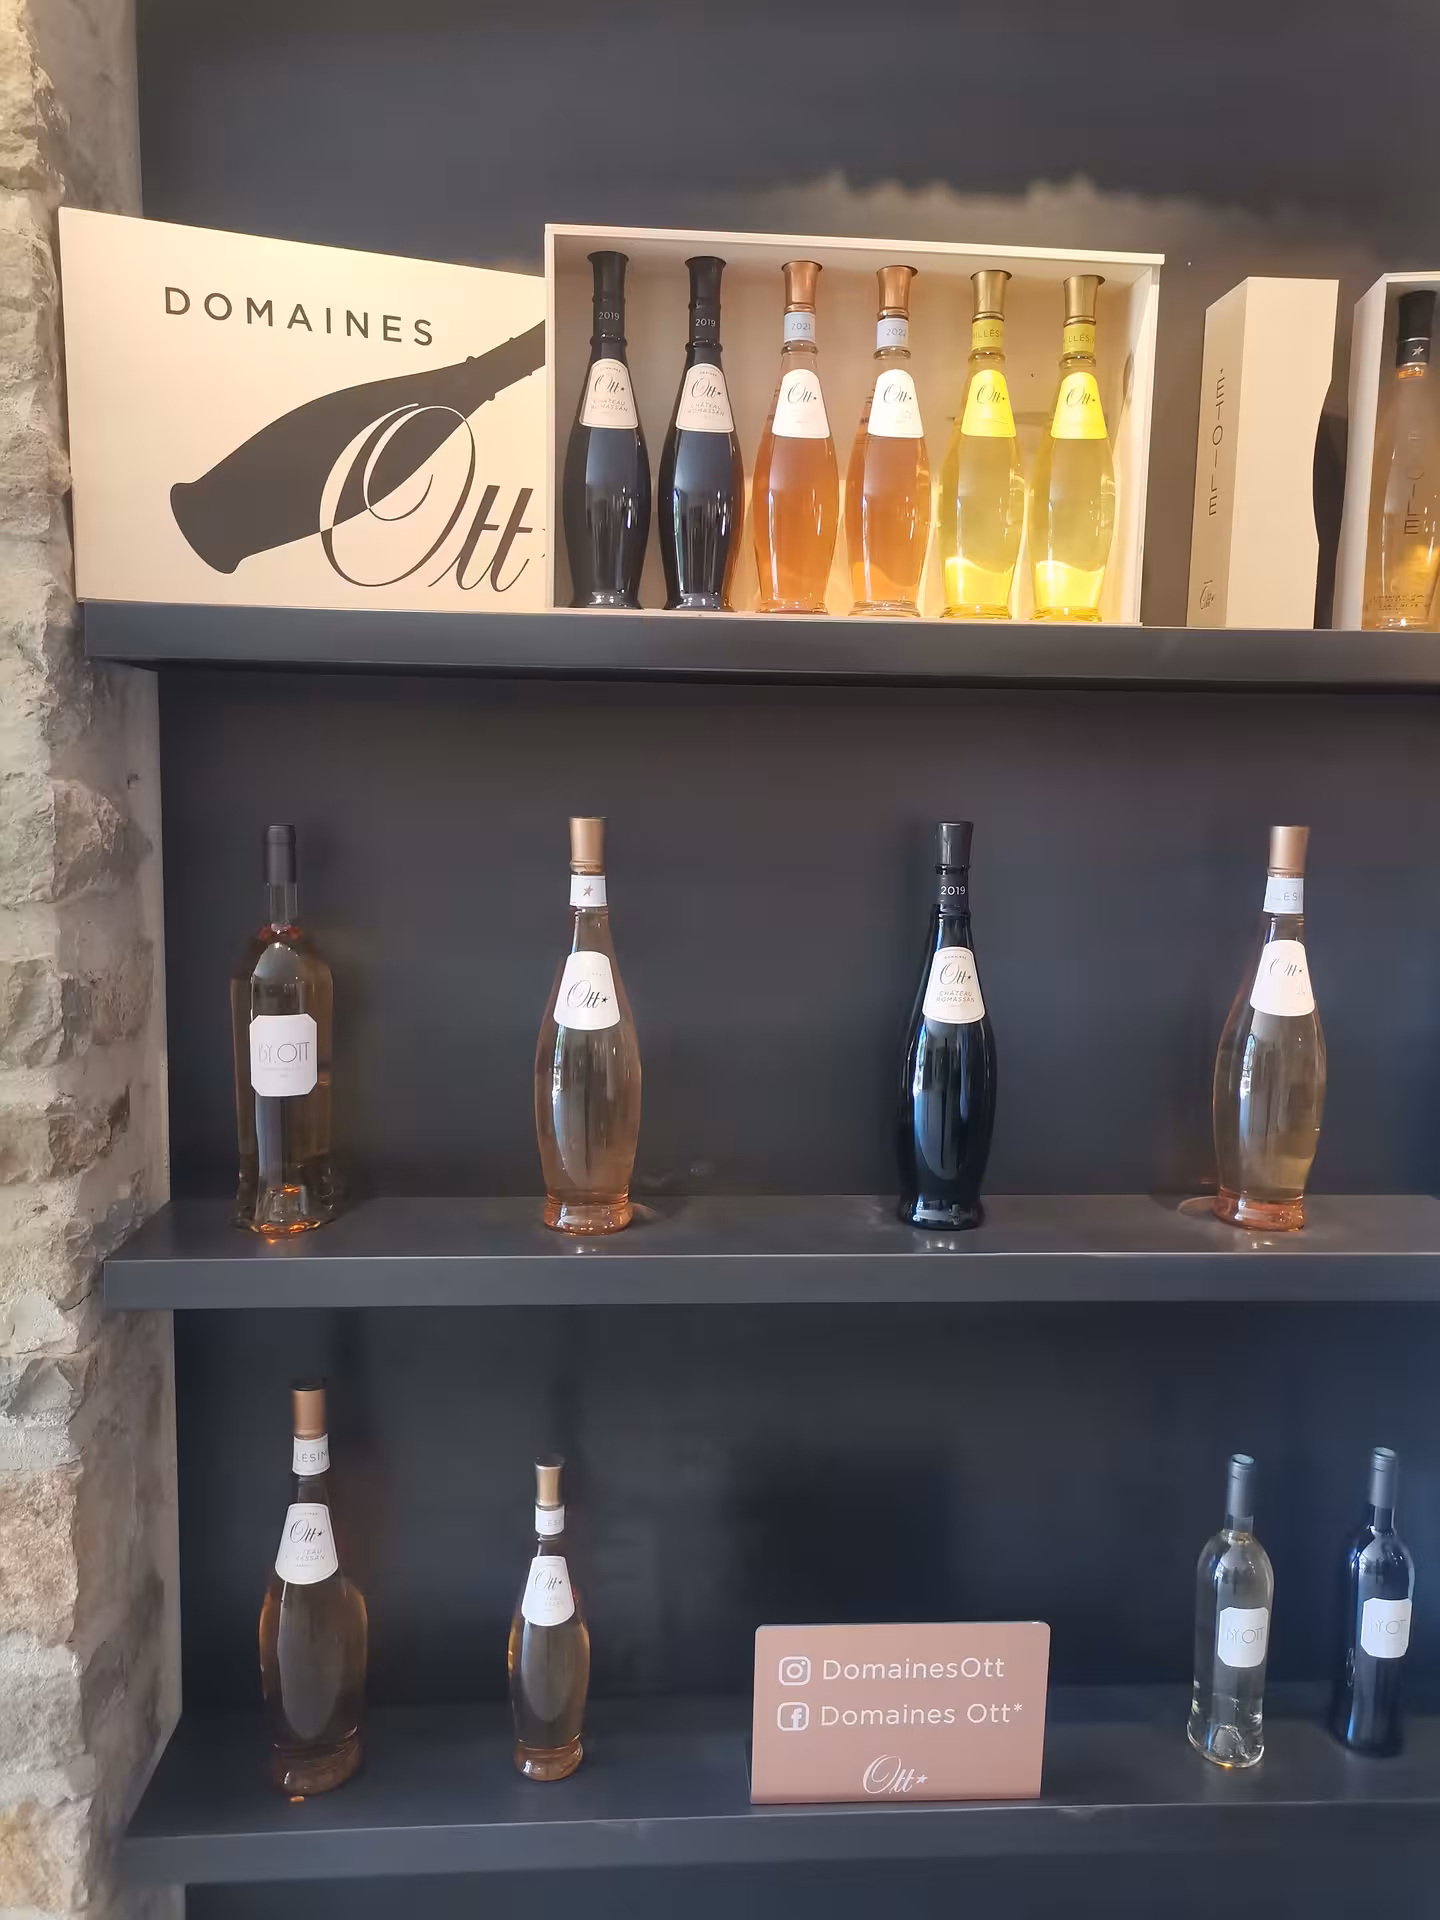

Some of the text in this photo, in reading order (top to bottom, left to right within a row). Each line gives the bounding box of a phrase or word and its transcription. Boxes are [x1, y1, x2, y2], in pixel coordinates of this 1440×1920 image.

[164, 285, 433, 347] DOMAINES
[598, 311, 620, 321] 2019
[694, 318, 716, 328] 2019
[940, 885, 967, 896] 2019
[822, 1657, 1005, 1681] DomainesOtt
[820, 1704, 956, 1727] Domaines
